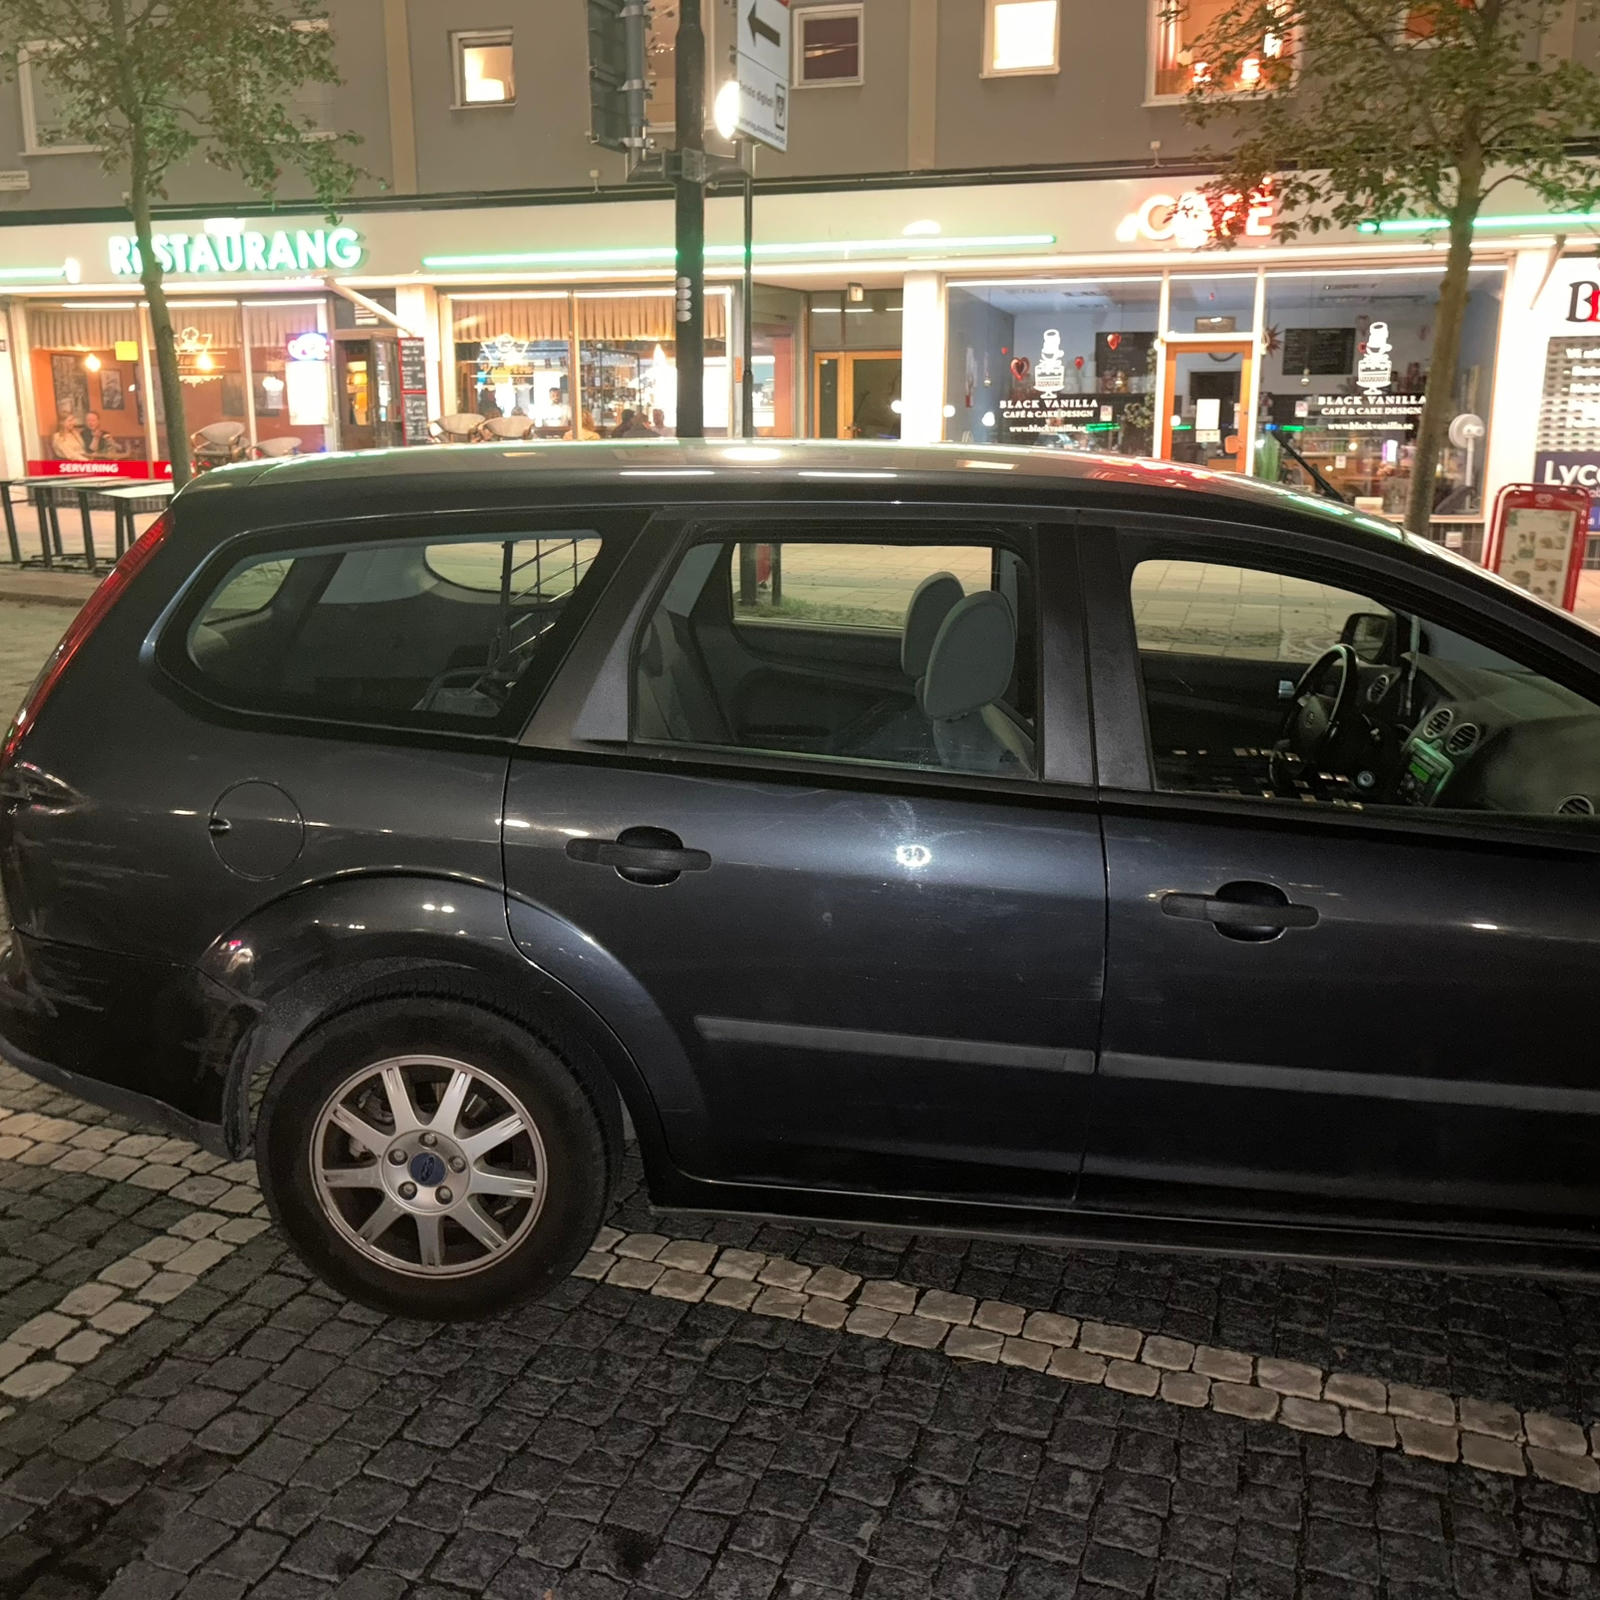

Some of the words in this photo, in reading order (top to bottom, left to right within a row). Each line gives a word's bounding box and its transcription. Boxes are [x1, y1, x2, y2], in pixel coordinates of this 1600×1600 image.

[999, 400, 1040, 409] BLACK
[1044, 399, 1098, 408] VANILLA
[1318, 396, 1363, 405] BLACK
[1367, 395, 1427, 405] VANILLA
[1003, 410, 1026, 418] CAFÉ
[1026, 410, 1034, 418] &
[1035, 410, 1058, 418] CAKE
[1060, 410, 1094, 418] DESIGN
[1321, 406, 1347, 415] CAFÉ
[1347, 407, 1355, 415] &
[1356, 407, 1383, 415] CAKE
[1384, 406, 1422, 415] DESIGN
[1327, 422, 1414, 430] www.blackvanilla.se
[59, 463, 119, 473] SERVERING
[1543, 460, 1600, 486] Lyc
